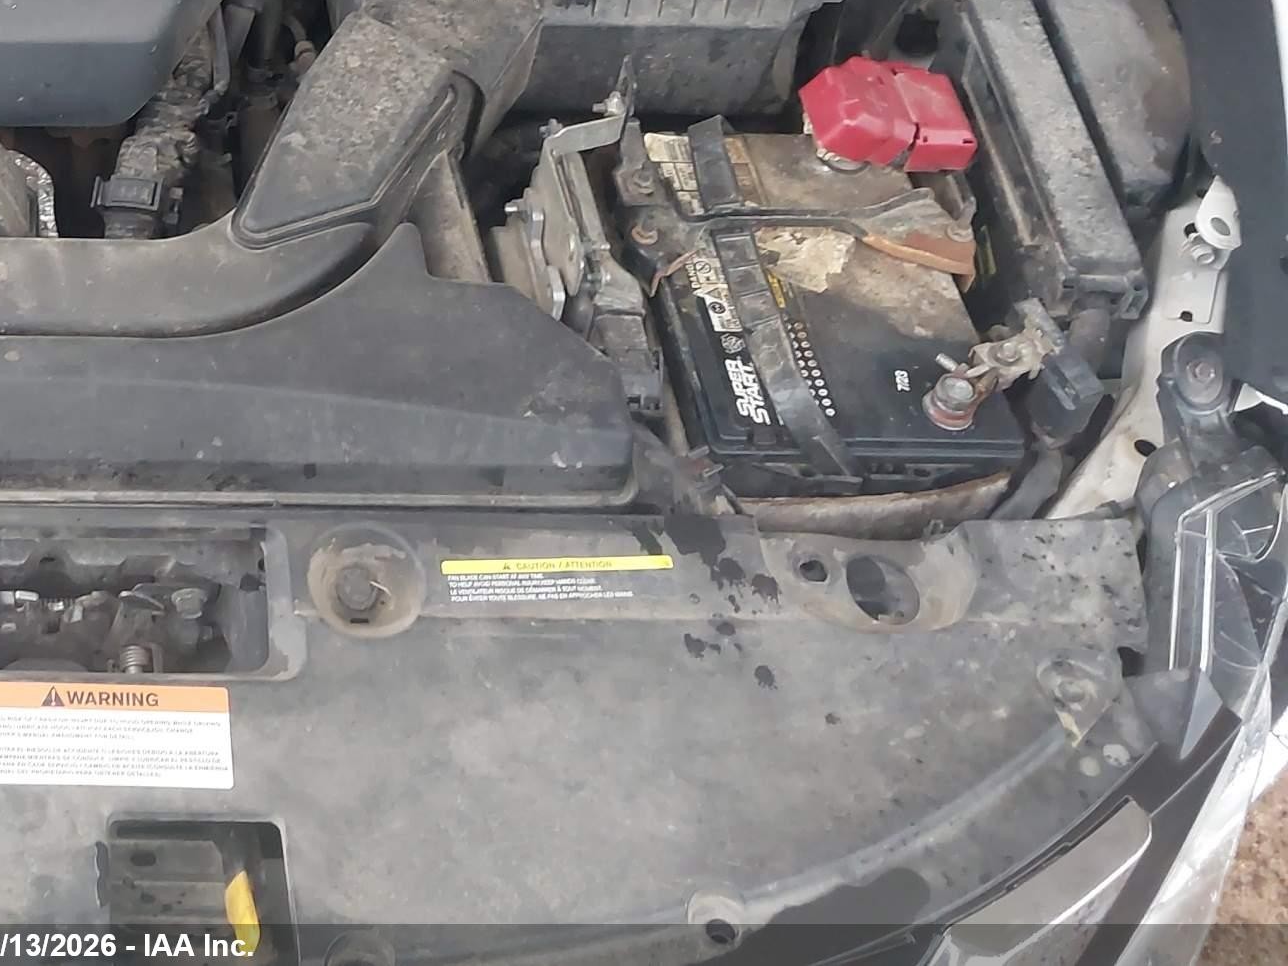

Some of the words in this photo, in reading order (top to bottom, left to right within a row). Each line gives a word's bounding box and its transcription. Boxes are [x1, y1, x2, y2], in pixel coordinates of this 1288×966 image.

[724, 357, 753, 418] SUPER
[515, 561, 556, 571] CAUTION
[565, 560, 613, 569] ATTENTION
[66, 690, 159, 707] WARNING
